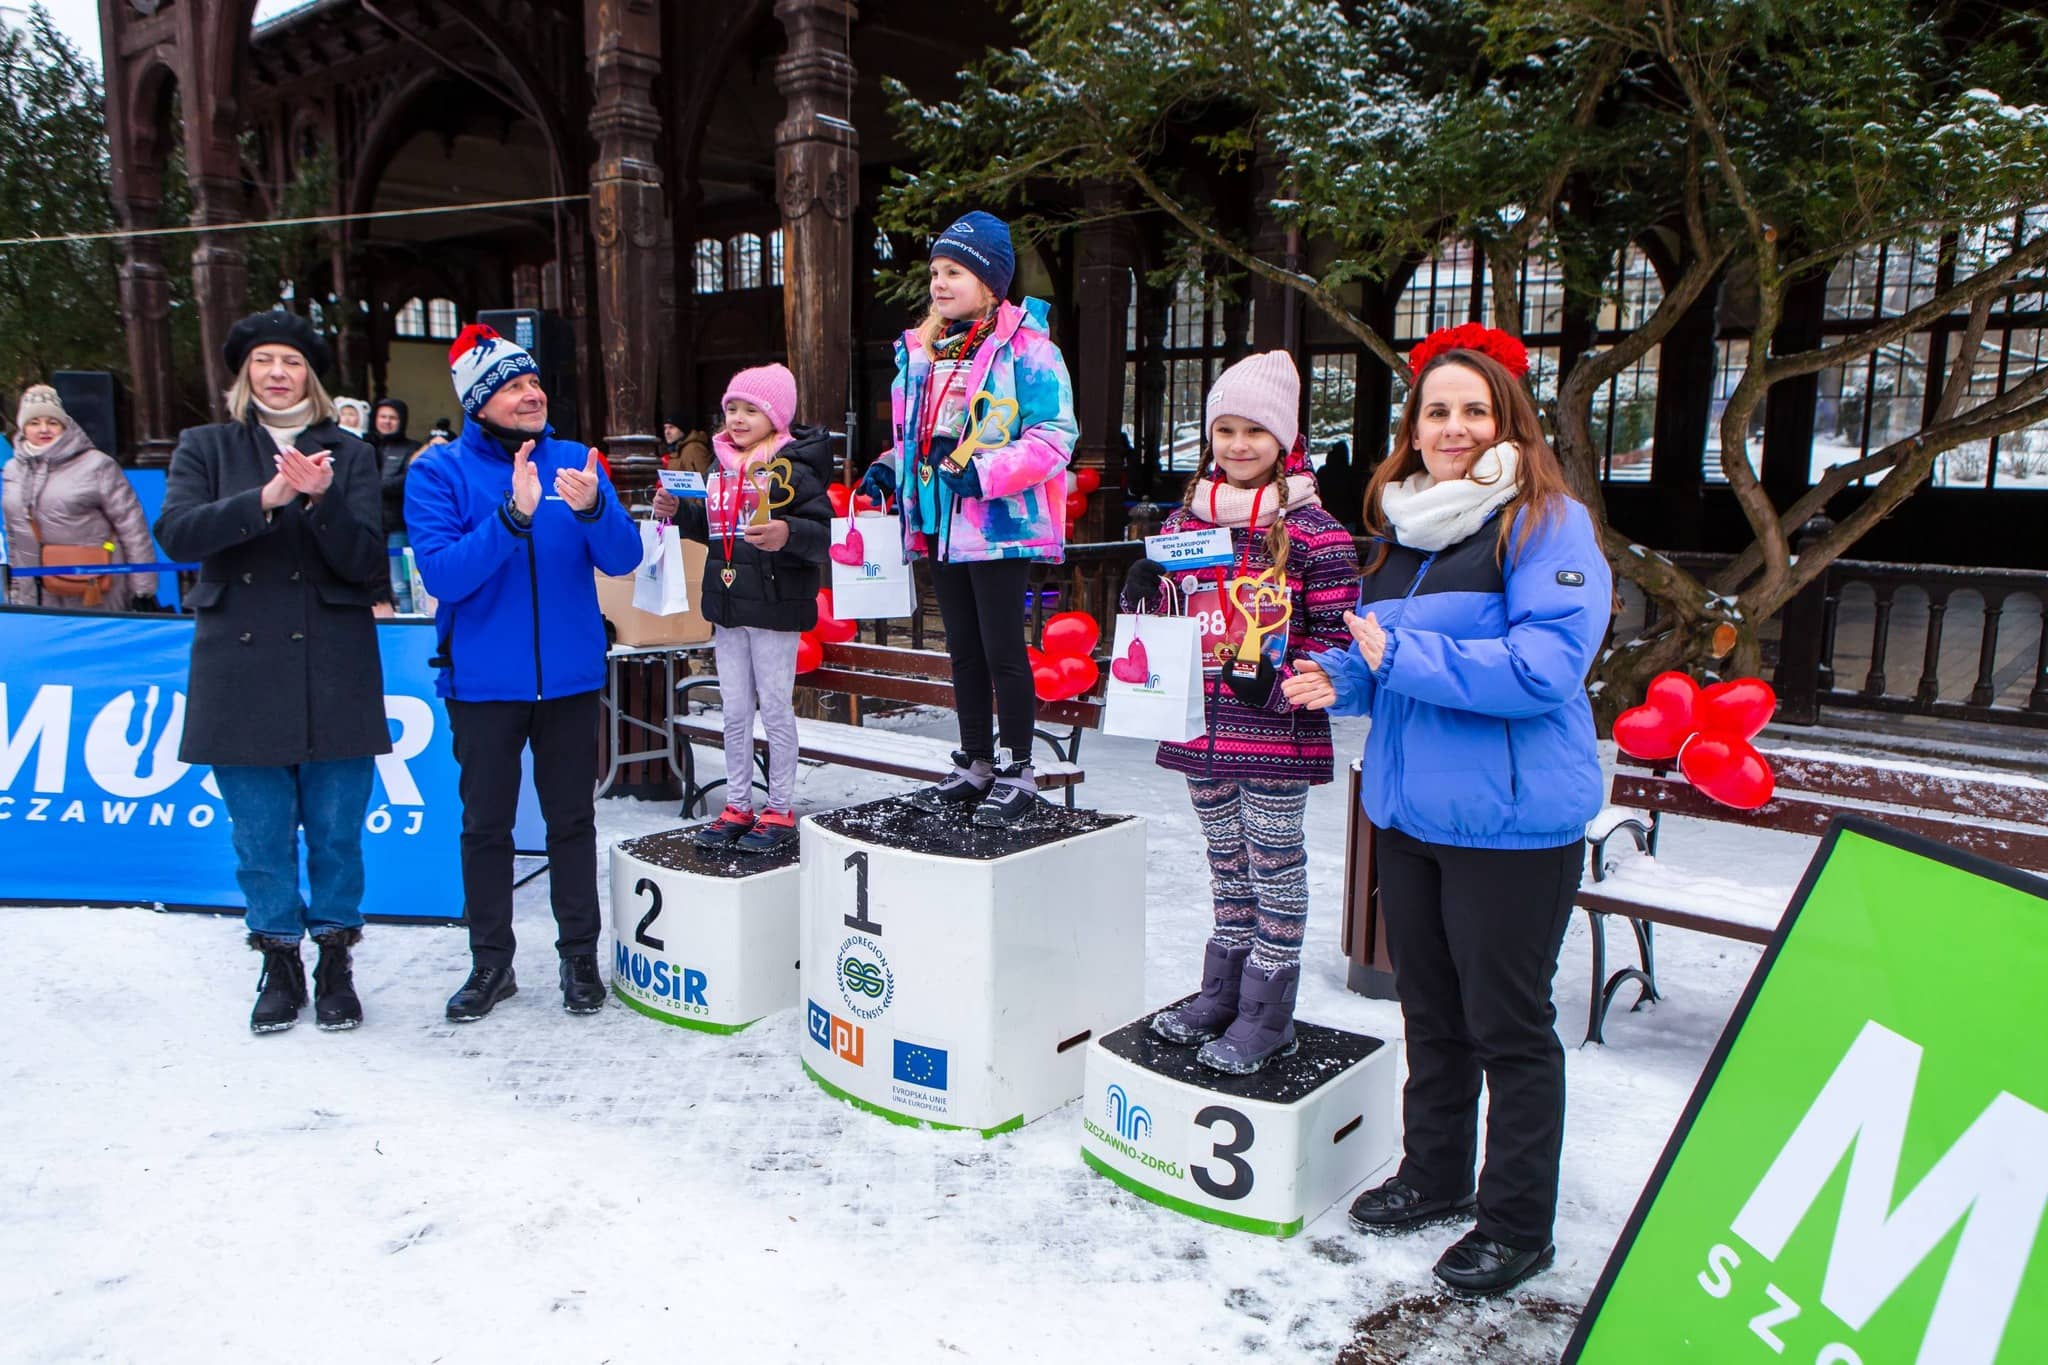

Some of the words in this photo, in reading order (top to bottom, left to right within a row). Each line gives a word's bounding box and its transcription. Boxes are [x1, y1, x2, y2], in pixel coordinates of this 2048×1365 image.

[1170, 550, 1182, 558] 20
[1184, 547, 1204, 556] PLN
[1176, 540, 1210, 549] ZAKUPOWY
[844, 850, 882, 936] 1
[635, 878, 664, 951] 2
[841, 935, 888, 967] EUROREGION
[843, 993, 884, 1020] GLACENSIS
[892, 1085, 928, 1101] EVROPSKÁ
[929, 1095, 947, 1105] UNIE
[892, 1095, 907, 1104] UNIA
[908, 1099, 948, 1113] EUROPEJSKA
[1083, 1116, 1184, 1180] SZCZAWNO-ZDRÓJ
[1189, 1105, 1255, 1200] 3
